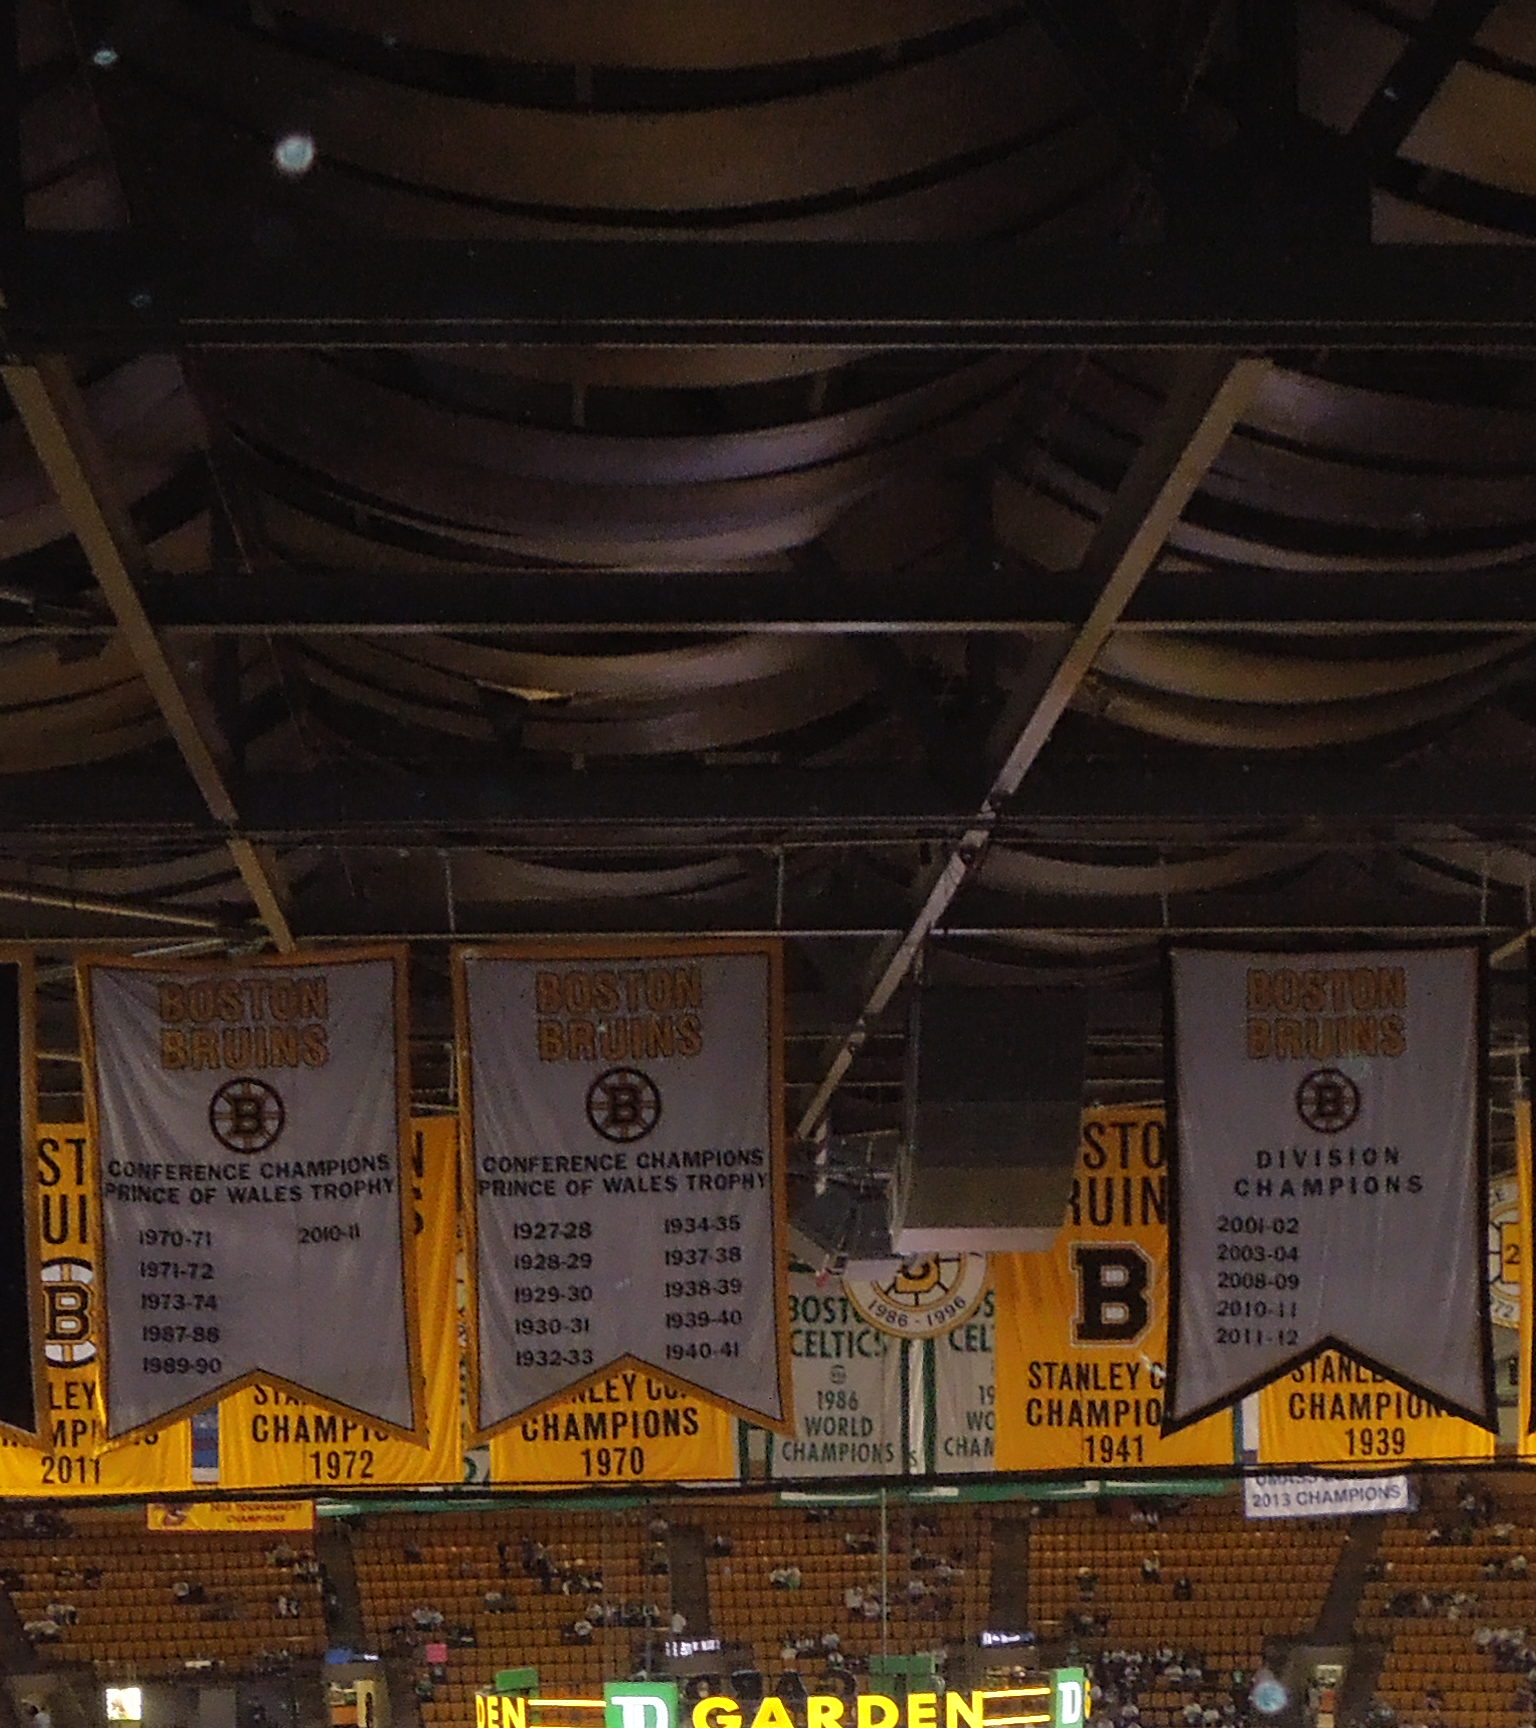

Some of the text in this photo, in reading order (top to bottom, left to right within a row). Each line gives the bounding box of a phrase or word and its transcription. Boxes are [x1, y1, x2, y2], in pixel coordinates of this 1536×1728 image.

[158, 976, 328, 1023] BOSTON
[535, 967, 702, 1014] BOSTON
[1247, 966, 1407, 1012] BOSTON
[160, 1024, 331, 1072] BRUINS
[536, 1014, 703, 1061] BRUINS
[1247, 1014, 1407, 1061] BRUINS
[108, 1160, 251, 1181] CONFERENCE
[260, 1153, 391, 1180] CHAMPIONS
[483, 1149, 764, 1173] CONFERENCE CHAMPIONS
[1257, 1146, 1400, 1170] DIVISION
[104, 1177, 395, 1205] PRINCE OF WALES TROPHY
[478, 1172, 767, 1197] PRINCE OF WALES TROPHY
[1234, 1174, 1423, 1198] CHAMPIONS
[139, 1230, 212, 1247] 1970-71
[514, 1214, 741, 1240] 1927-28 1934-35
[140, 1261, 214, 1280] 1971-72
[514, 1247, 741, 1270] 1928-29 1937-38
[141, 1293, 218, 1311] 1973-74
[515, 1278, 742, 1303] 1929-30 1938-39
[1070, 1241, 1155, 1349] B
[515, 1310, 742, 1335] 1930-31 1939-40
[868, 1300, 908, 1327] 1986
[926, 1298, 966, 1326] 1996
[516, 1342, 739, 1367] 1932-33 1940-41
[791, 1329, 887, 1359] CELTICS
[1028, 1360, 1140, 1391] STANLEY
[816, 1390, 859, 1411] 1986
[1026, 1398, 1163, 1428] CHAMPIO
[522, 1407, 699, 1442] CHAMPIONS
[804, 1417, 873, 1438] WORLD
[782, 1440, 894, 1464] CHAMPIONS
[1085, 1435, 1144, 1462] 1941
[1344, 1427, 1405, 1456] 1939
[42, 1456, 100, 1485] 2011
[310, 1450, 374, 1479] 1972
[581, 1446, 644, 1476] 1970
[1252, 1485, 1401, 1507] 2013 CHAMPIONS
